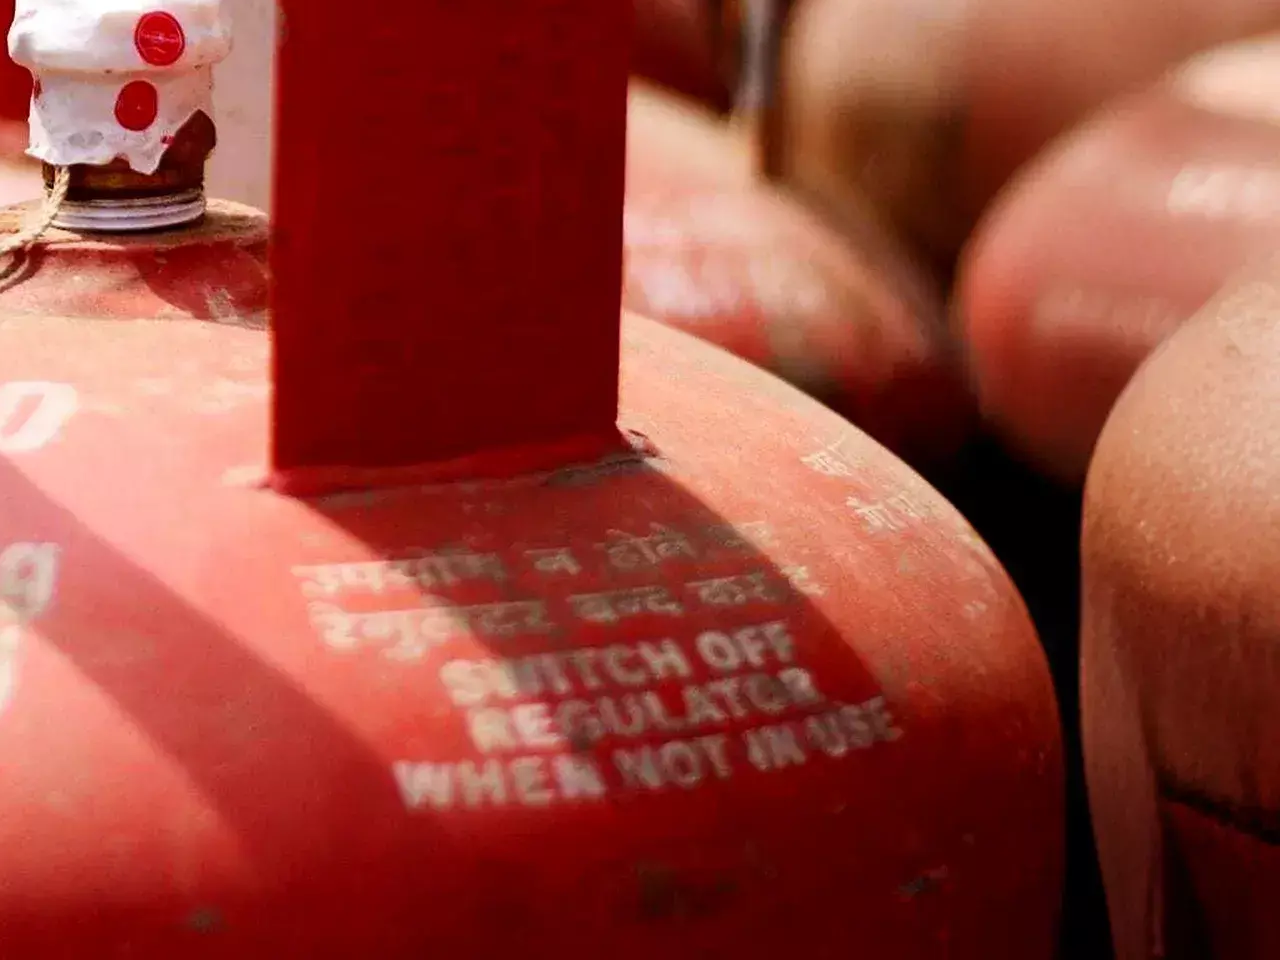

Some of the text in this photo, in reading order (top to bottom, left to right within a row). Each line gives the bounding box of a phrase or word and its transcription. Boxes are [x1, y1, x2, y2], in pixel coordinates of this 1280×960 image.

[438, 620, 797, 708] SWITCH OFF
[392, 694, 906, 814] WHEN NOT IN USE
[465, 666, 823, 755] REGULATOR
